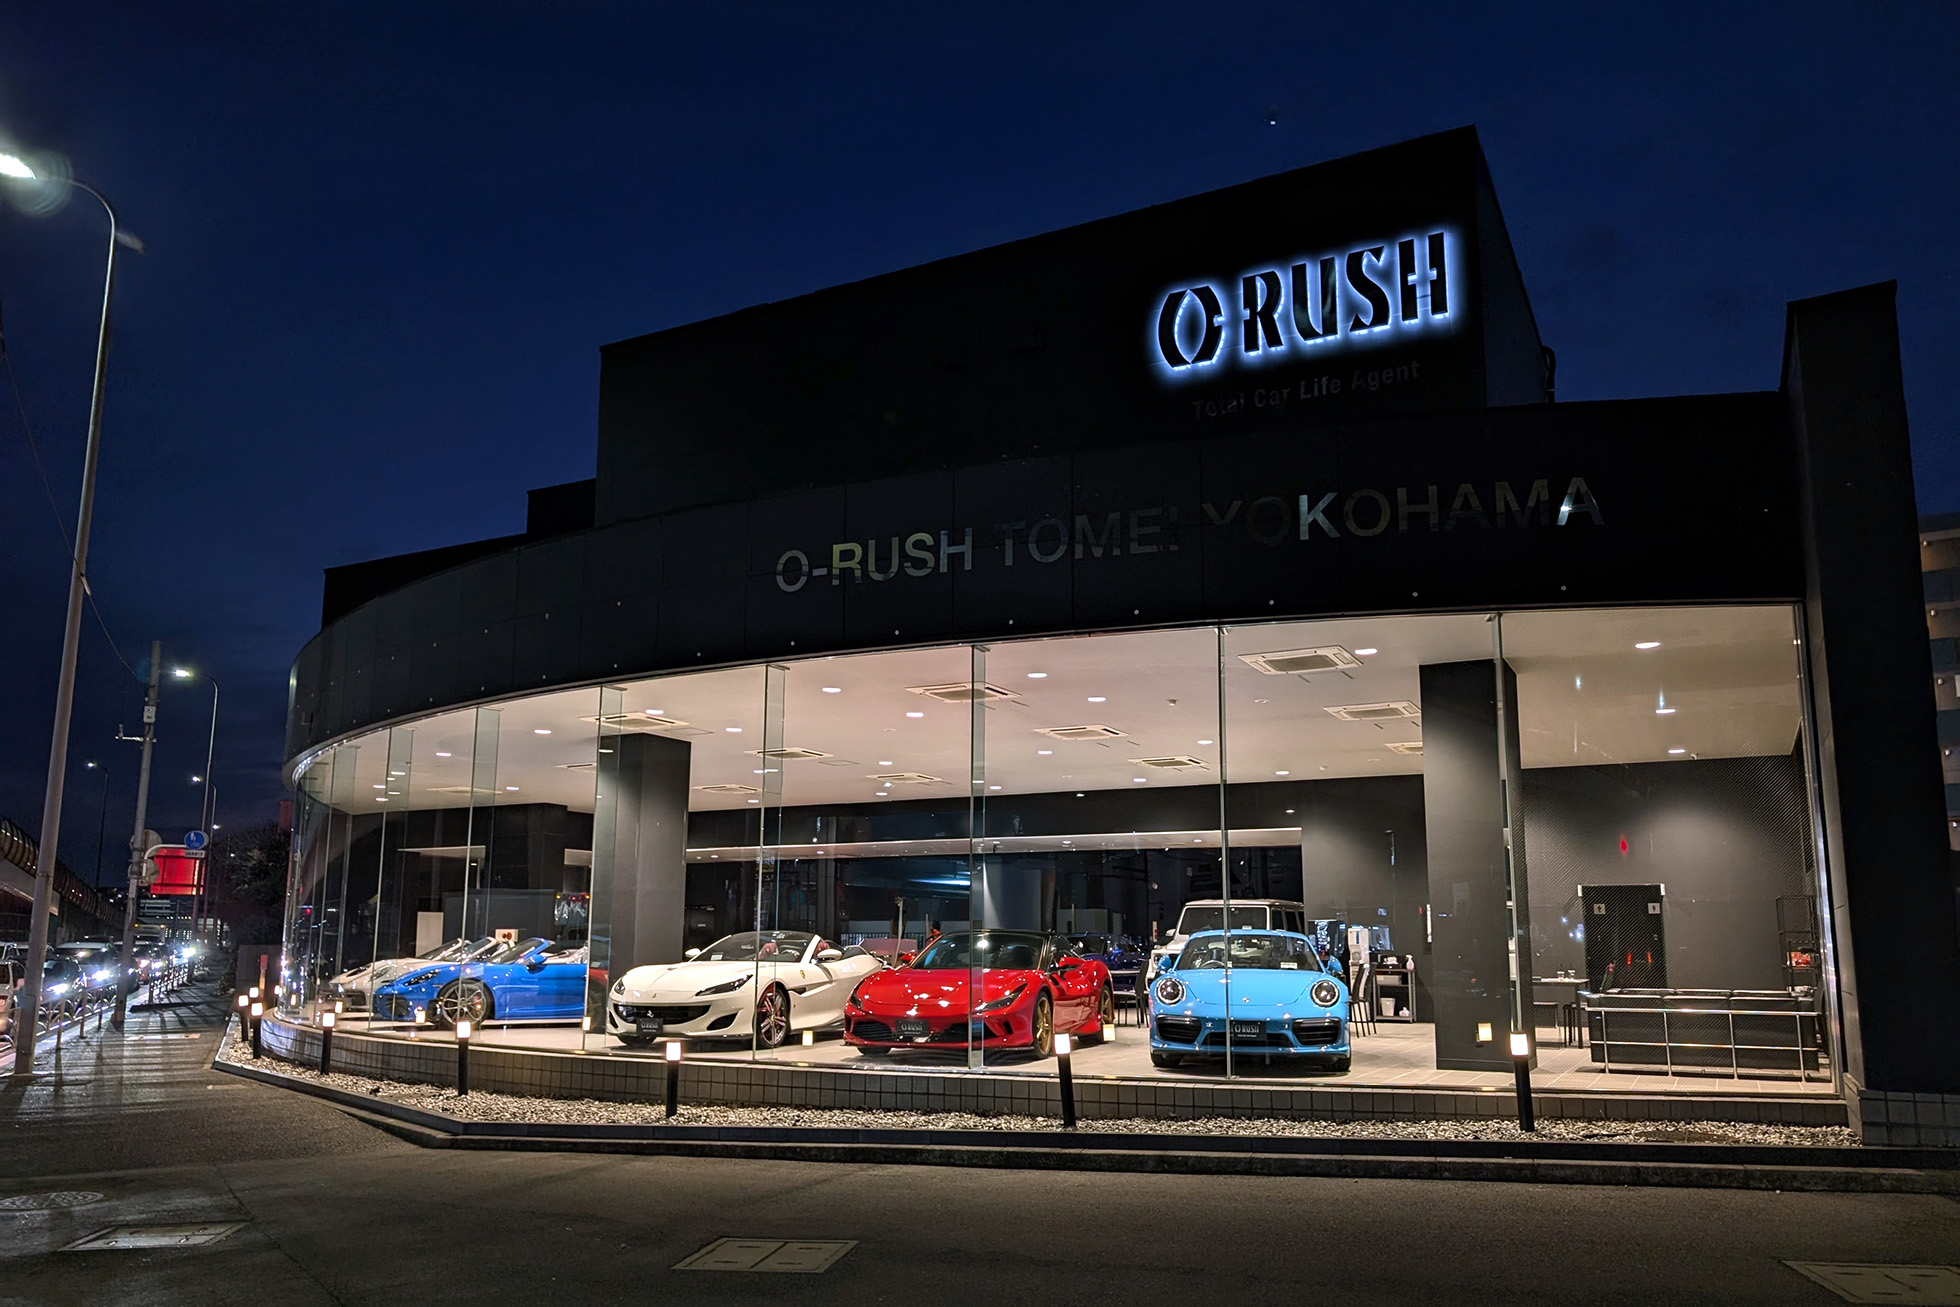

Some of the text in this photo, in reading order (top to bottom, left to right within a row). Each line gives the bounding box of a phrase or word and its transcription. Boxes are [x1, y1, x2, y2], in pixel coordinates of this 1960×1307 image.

[1253, 387, 1291, 408] Car
[1299, 375, 1342, 401] Life
[1351, 360, 1421, 391] Agent
[775, 527, 974, 593] O-RUSH
[1201, 475, 1606, 548] YOKOHAMA
